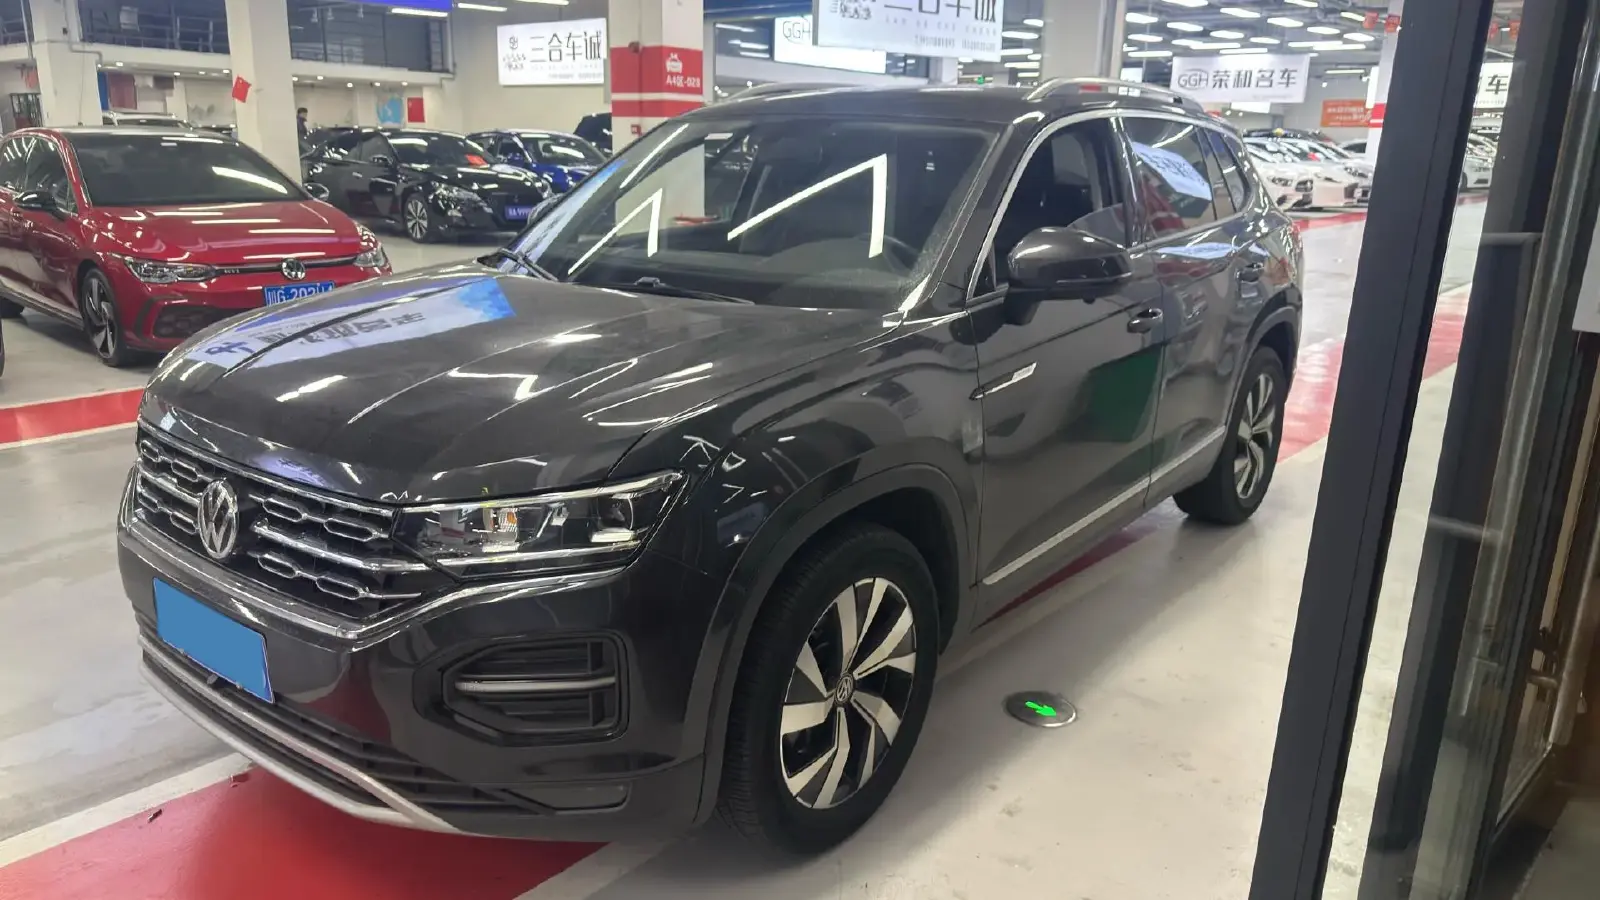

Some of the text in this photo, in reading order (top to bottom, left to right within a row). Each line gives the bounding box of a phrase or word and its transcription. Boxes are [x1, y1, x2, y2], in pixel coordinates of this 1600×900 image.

[530, 30, 602, 62] 三合车诚
[1212, 67, 1298, 89] 荣和名车
